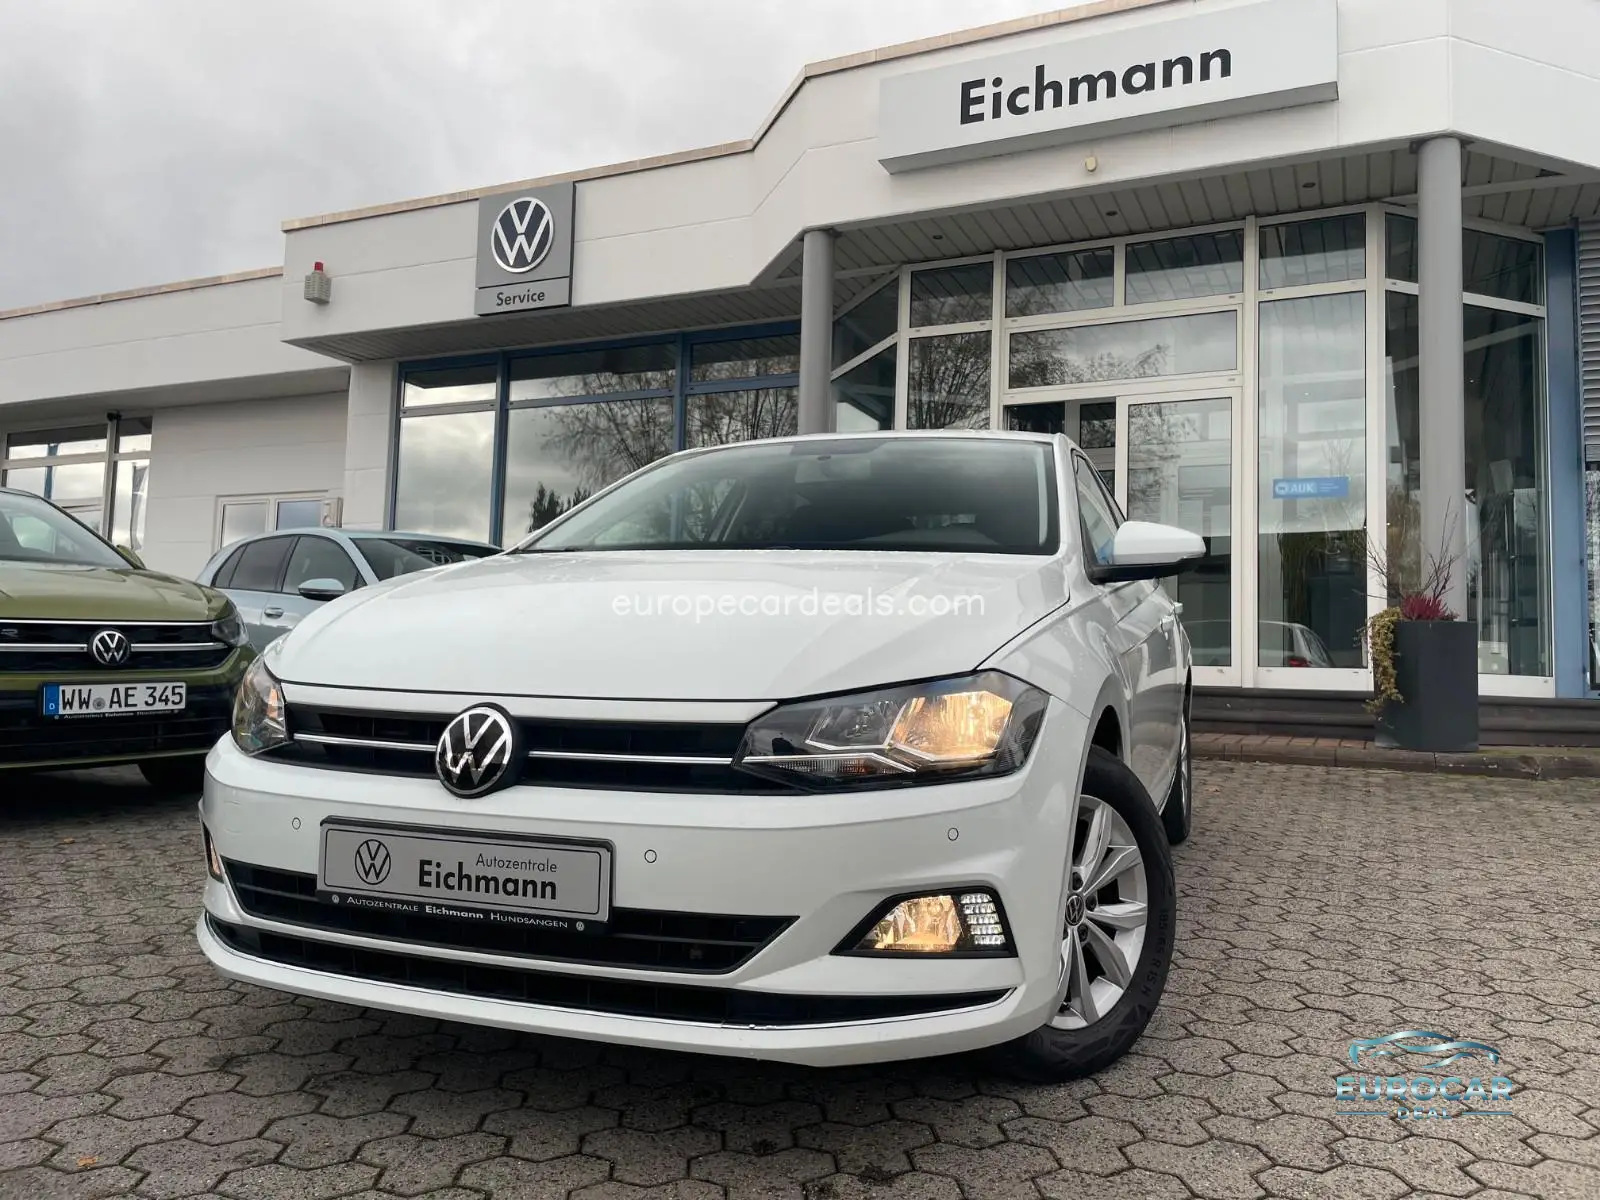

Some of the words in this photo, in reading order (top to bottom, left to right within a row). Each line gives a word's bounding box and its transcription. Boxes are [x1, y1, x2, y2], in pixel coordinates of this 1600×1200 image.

[960, 47, 1232, 126] Eichmann
[496, 289, 546, 307] Service
[61, 688, 91, 711] WW
[109, 686, 138, 708] AE
[144, 684, 184, 707] 345
[475, 852, 558, 873] Autozentrale
[418, 859, 557, 900] Eichmann
[425, 904, 484, 920] Eichmann
